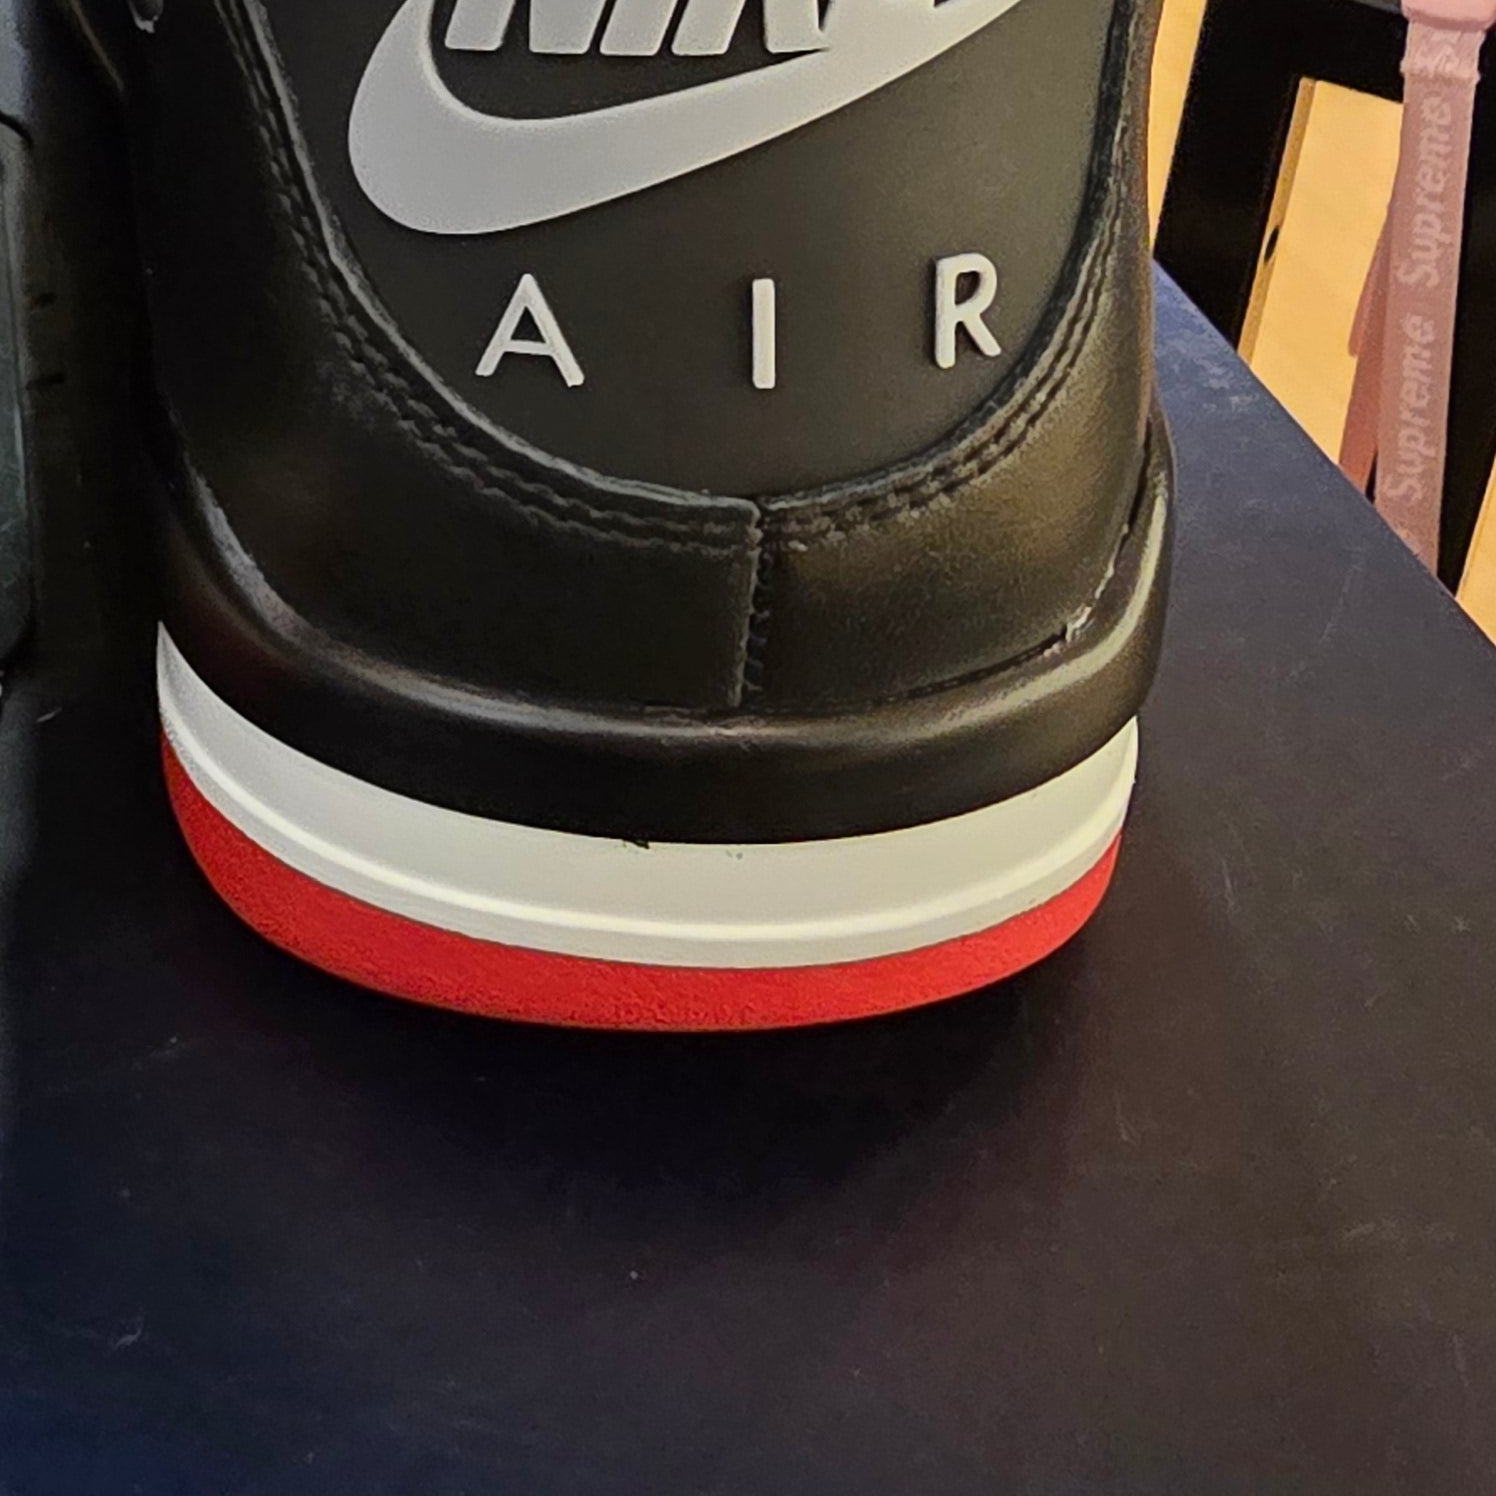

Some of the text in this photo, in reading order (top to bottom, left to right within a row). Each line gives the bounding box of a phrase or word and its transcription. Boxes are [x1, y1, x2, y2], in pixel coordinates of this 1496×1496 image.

[1397, 93, 1452, 287] Supreme
[475, 252, 1002, 390] AIR
[1385, 312, 1435, 502] Supreme
